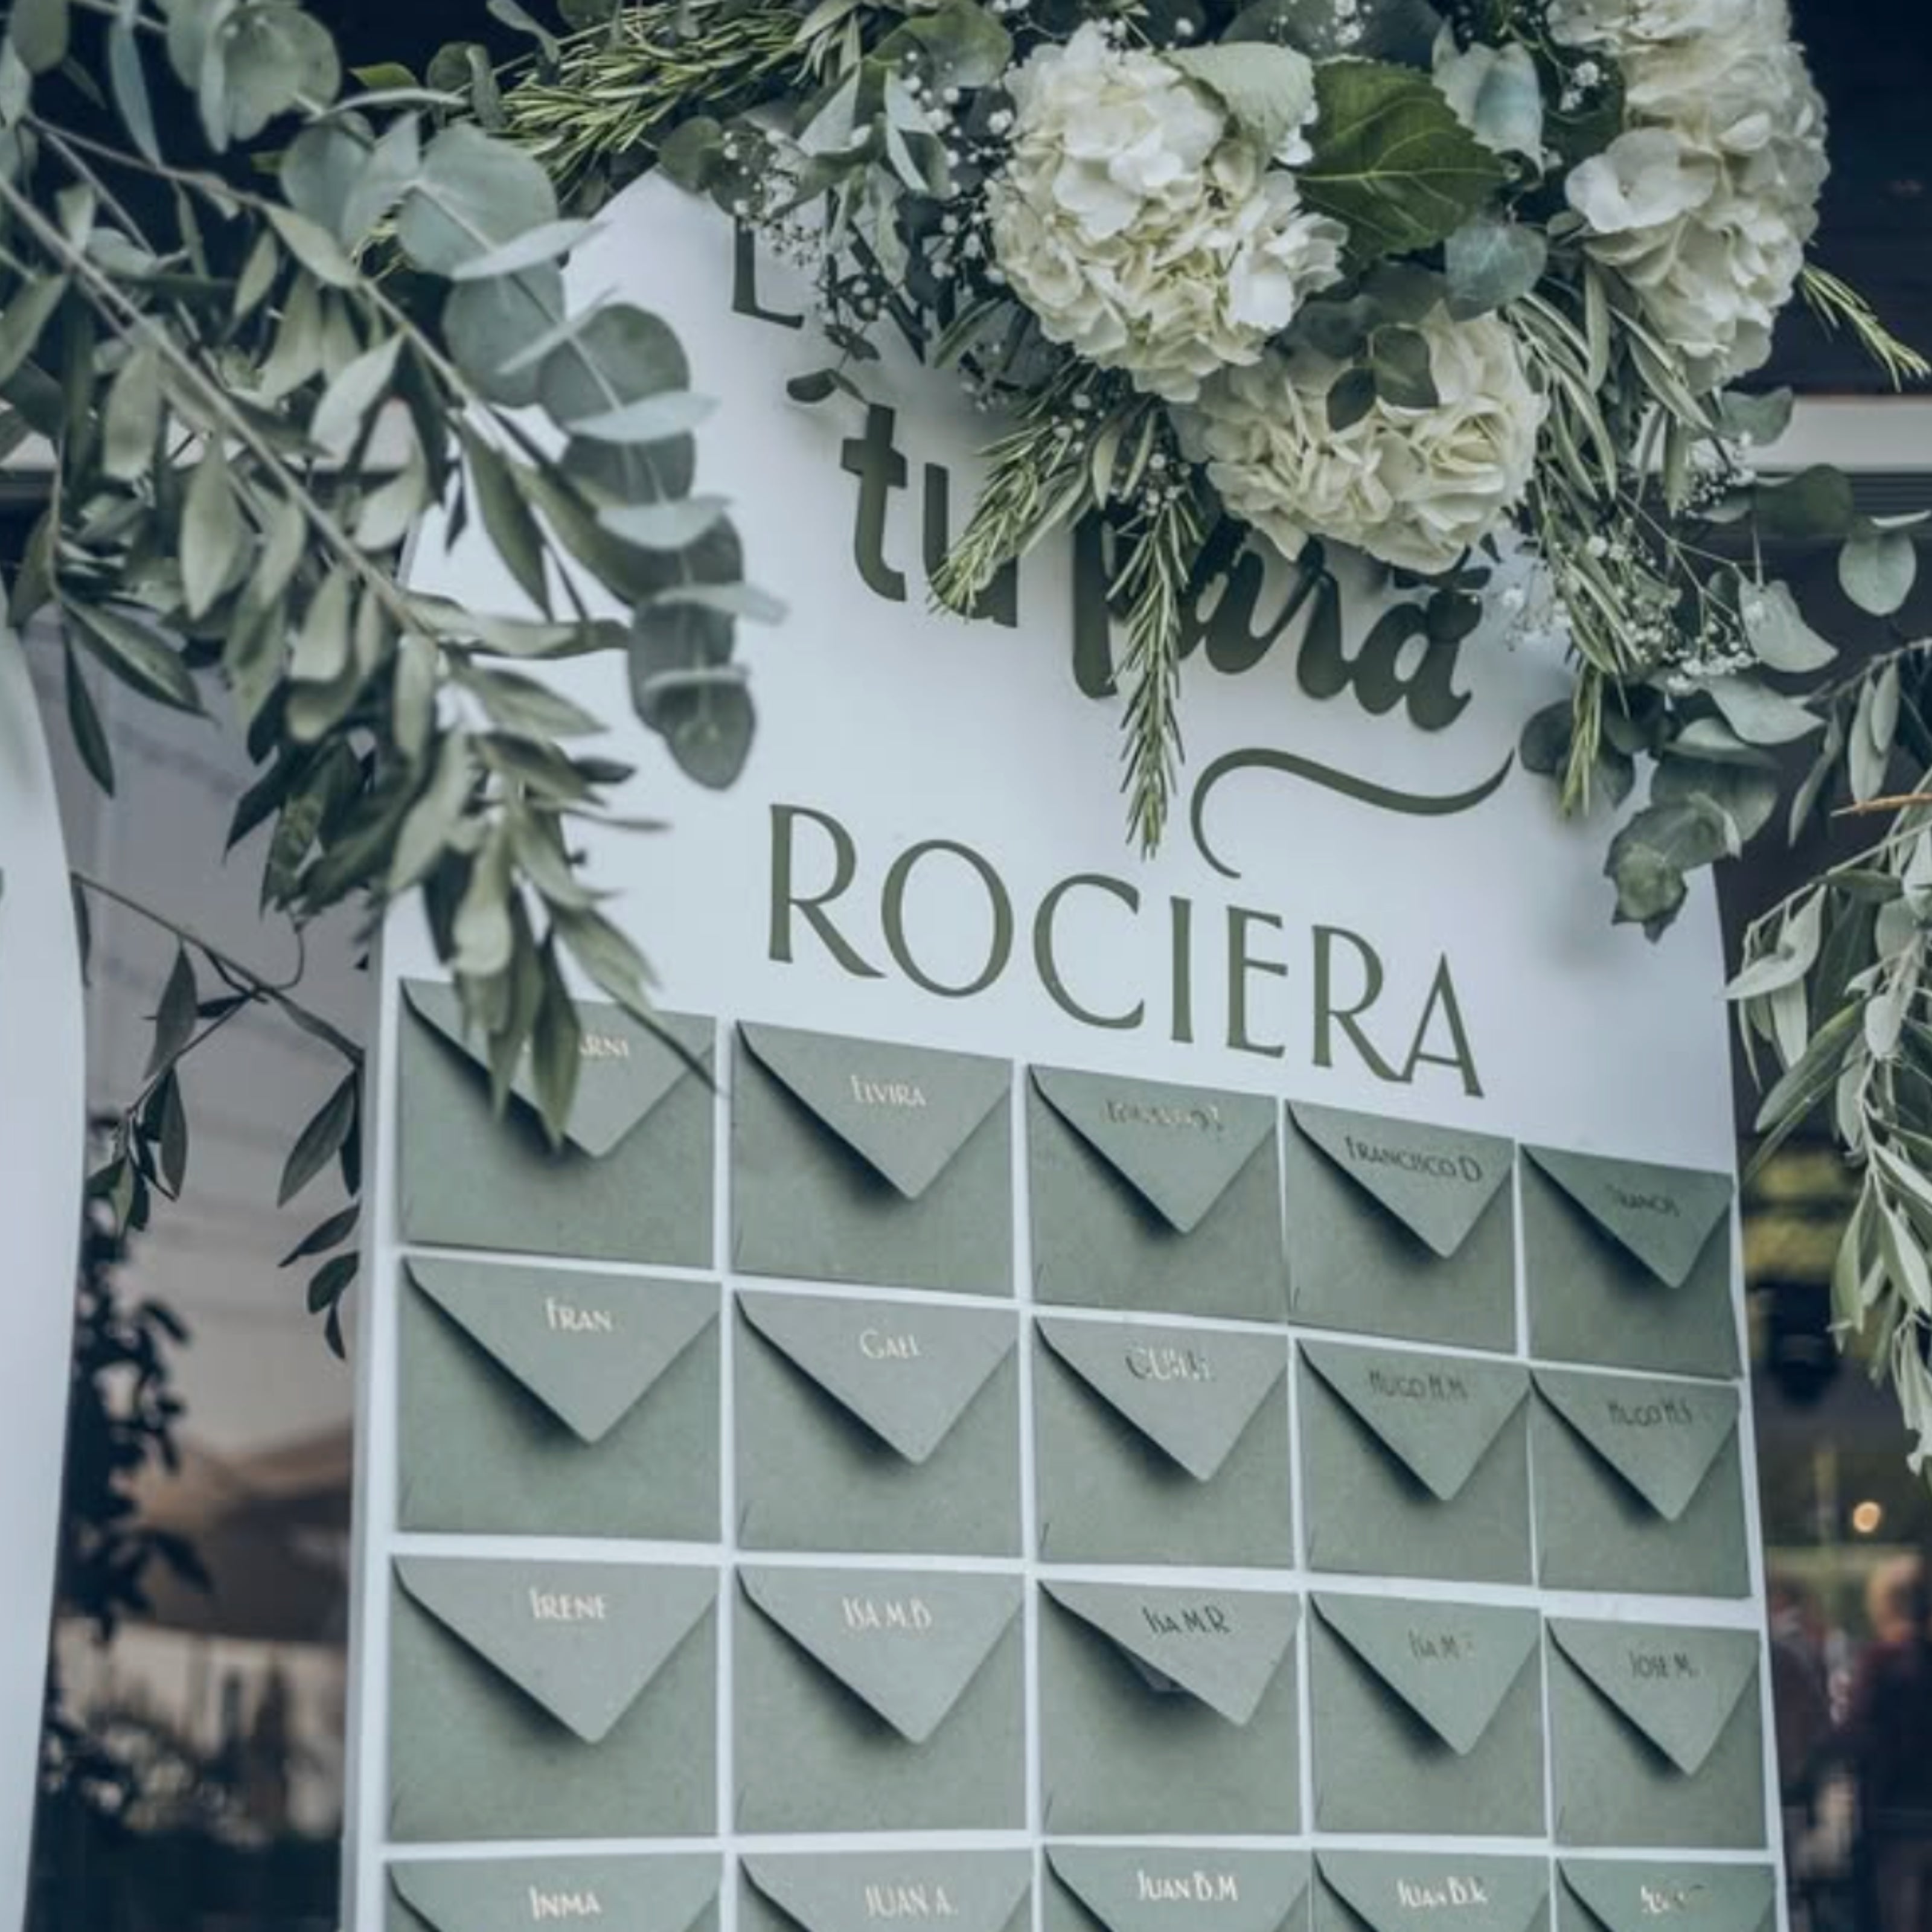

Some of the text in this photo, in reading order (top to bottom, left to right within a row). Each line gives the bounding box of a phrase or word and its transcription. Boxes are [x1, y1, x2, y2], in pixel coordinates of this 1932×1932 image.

[768, 804, 1484, 1099] ROCIERA
[546, 1296, 612, 1332] FRAN
[529, 1587, 606, 1620] IRENE
[528, 1884, 603, 1922] INMA
[864, 1882, 931, 1919] JUAN
[1136, 1869, 1192, 1902] JUAN
